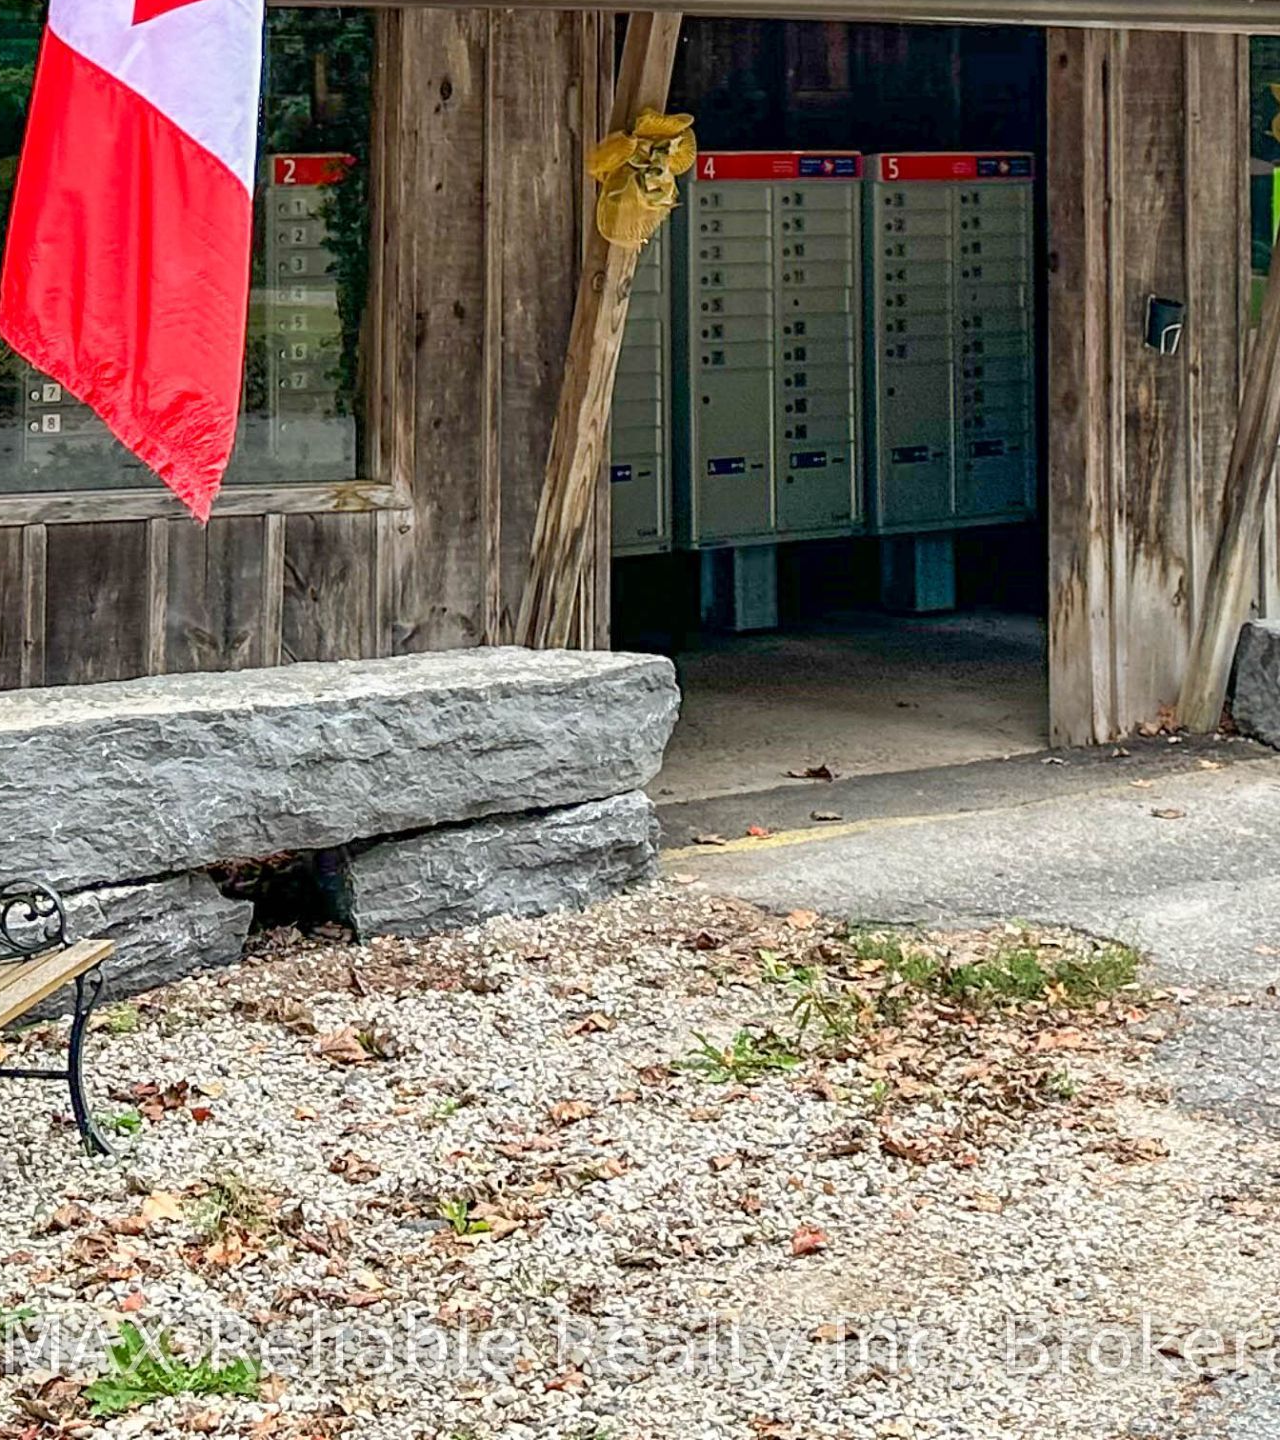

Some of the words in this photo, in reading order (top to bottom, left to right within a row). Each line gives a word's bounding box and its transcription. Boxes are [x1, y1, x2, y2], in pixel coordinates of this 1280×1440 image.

[283, 160, 296, 183] 2
[704, 157, 716, 179] 4
[888, 158, 899, 179] 5
